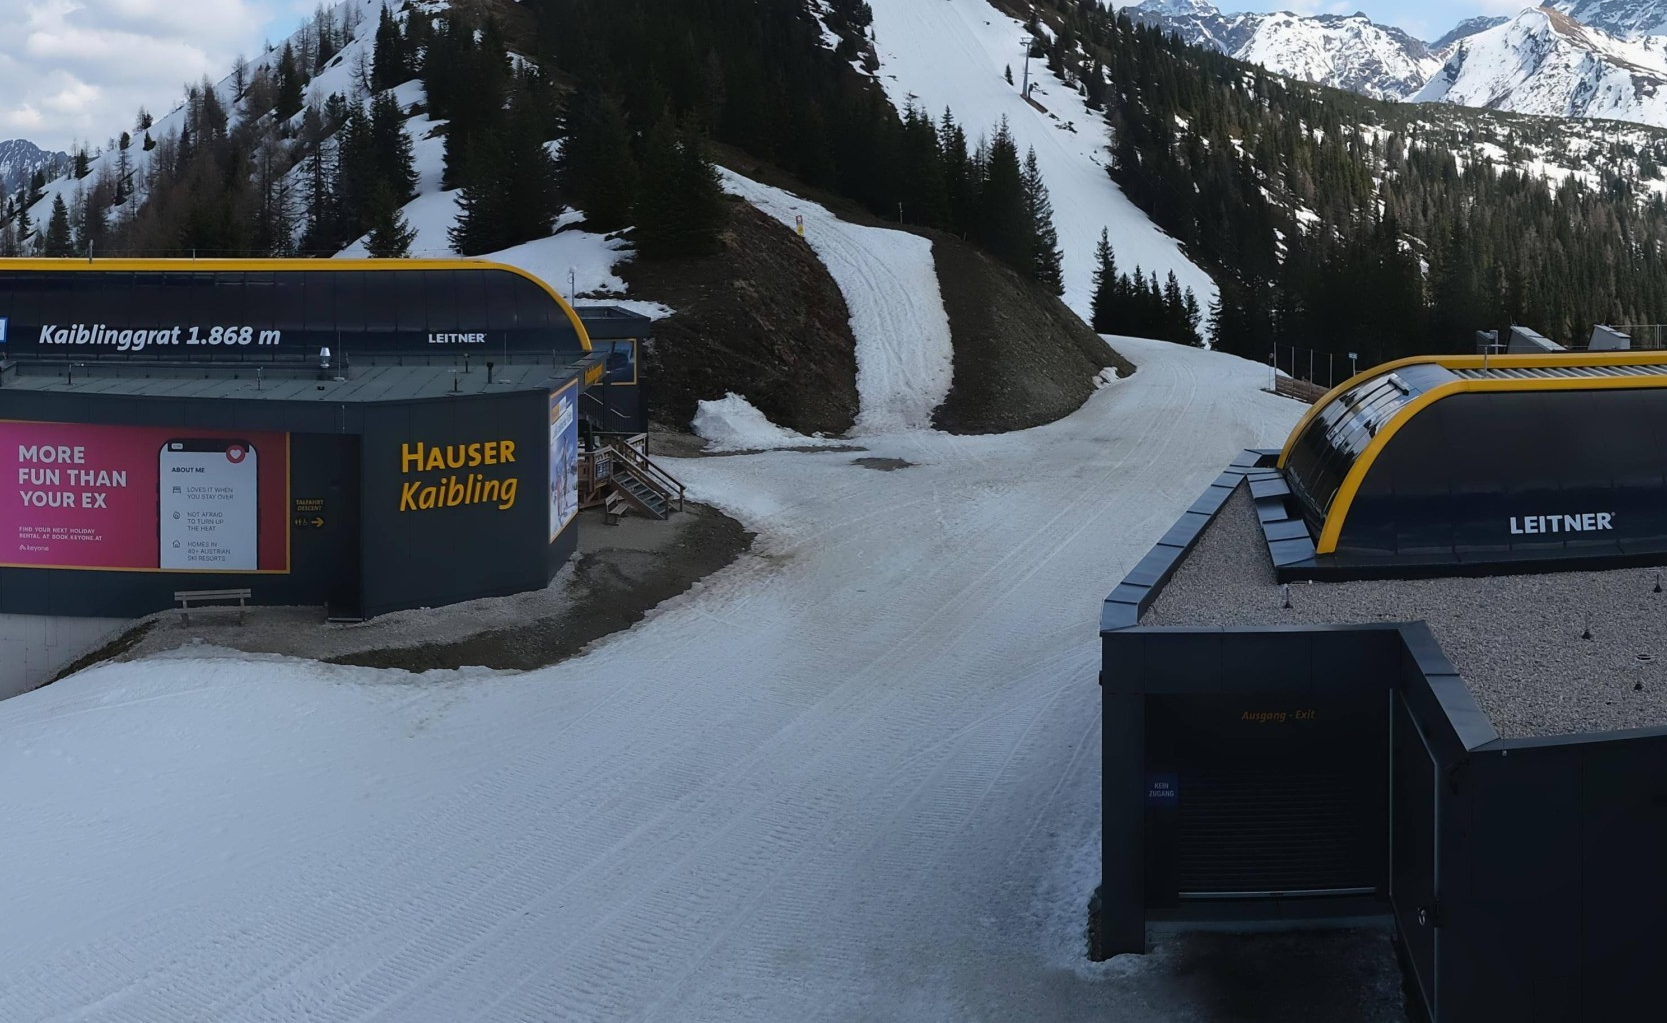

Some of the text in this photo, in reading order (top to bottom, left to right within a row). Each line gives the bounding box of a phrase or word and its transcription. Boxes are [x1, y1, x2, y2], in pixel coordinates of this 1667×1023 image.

[39, 324, 281, 351] Kaiblinggrat 1.868 m
[428, 333, 486, 343] LEITNER
[18, 445, 85, 463] MORE
[402, 440, 516, 473] HAUSER
[18, 468, 127, 487] FUN THAN
[19, 490, 107, 508] YOUR EX
[400, 473, 518, 512] Kaibling
[1509, 512, 1614, 534] LEITNER
[1241, 711, 1286, 722] Ausgang
[1295, 709, 1315, 720] Exit
